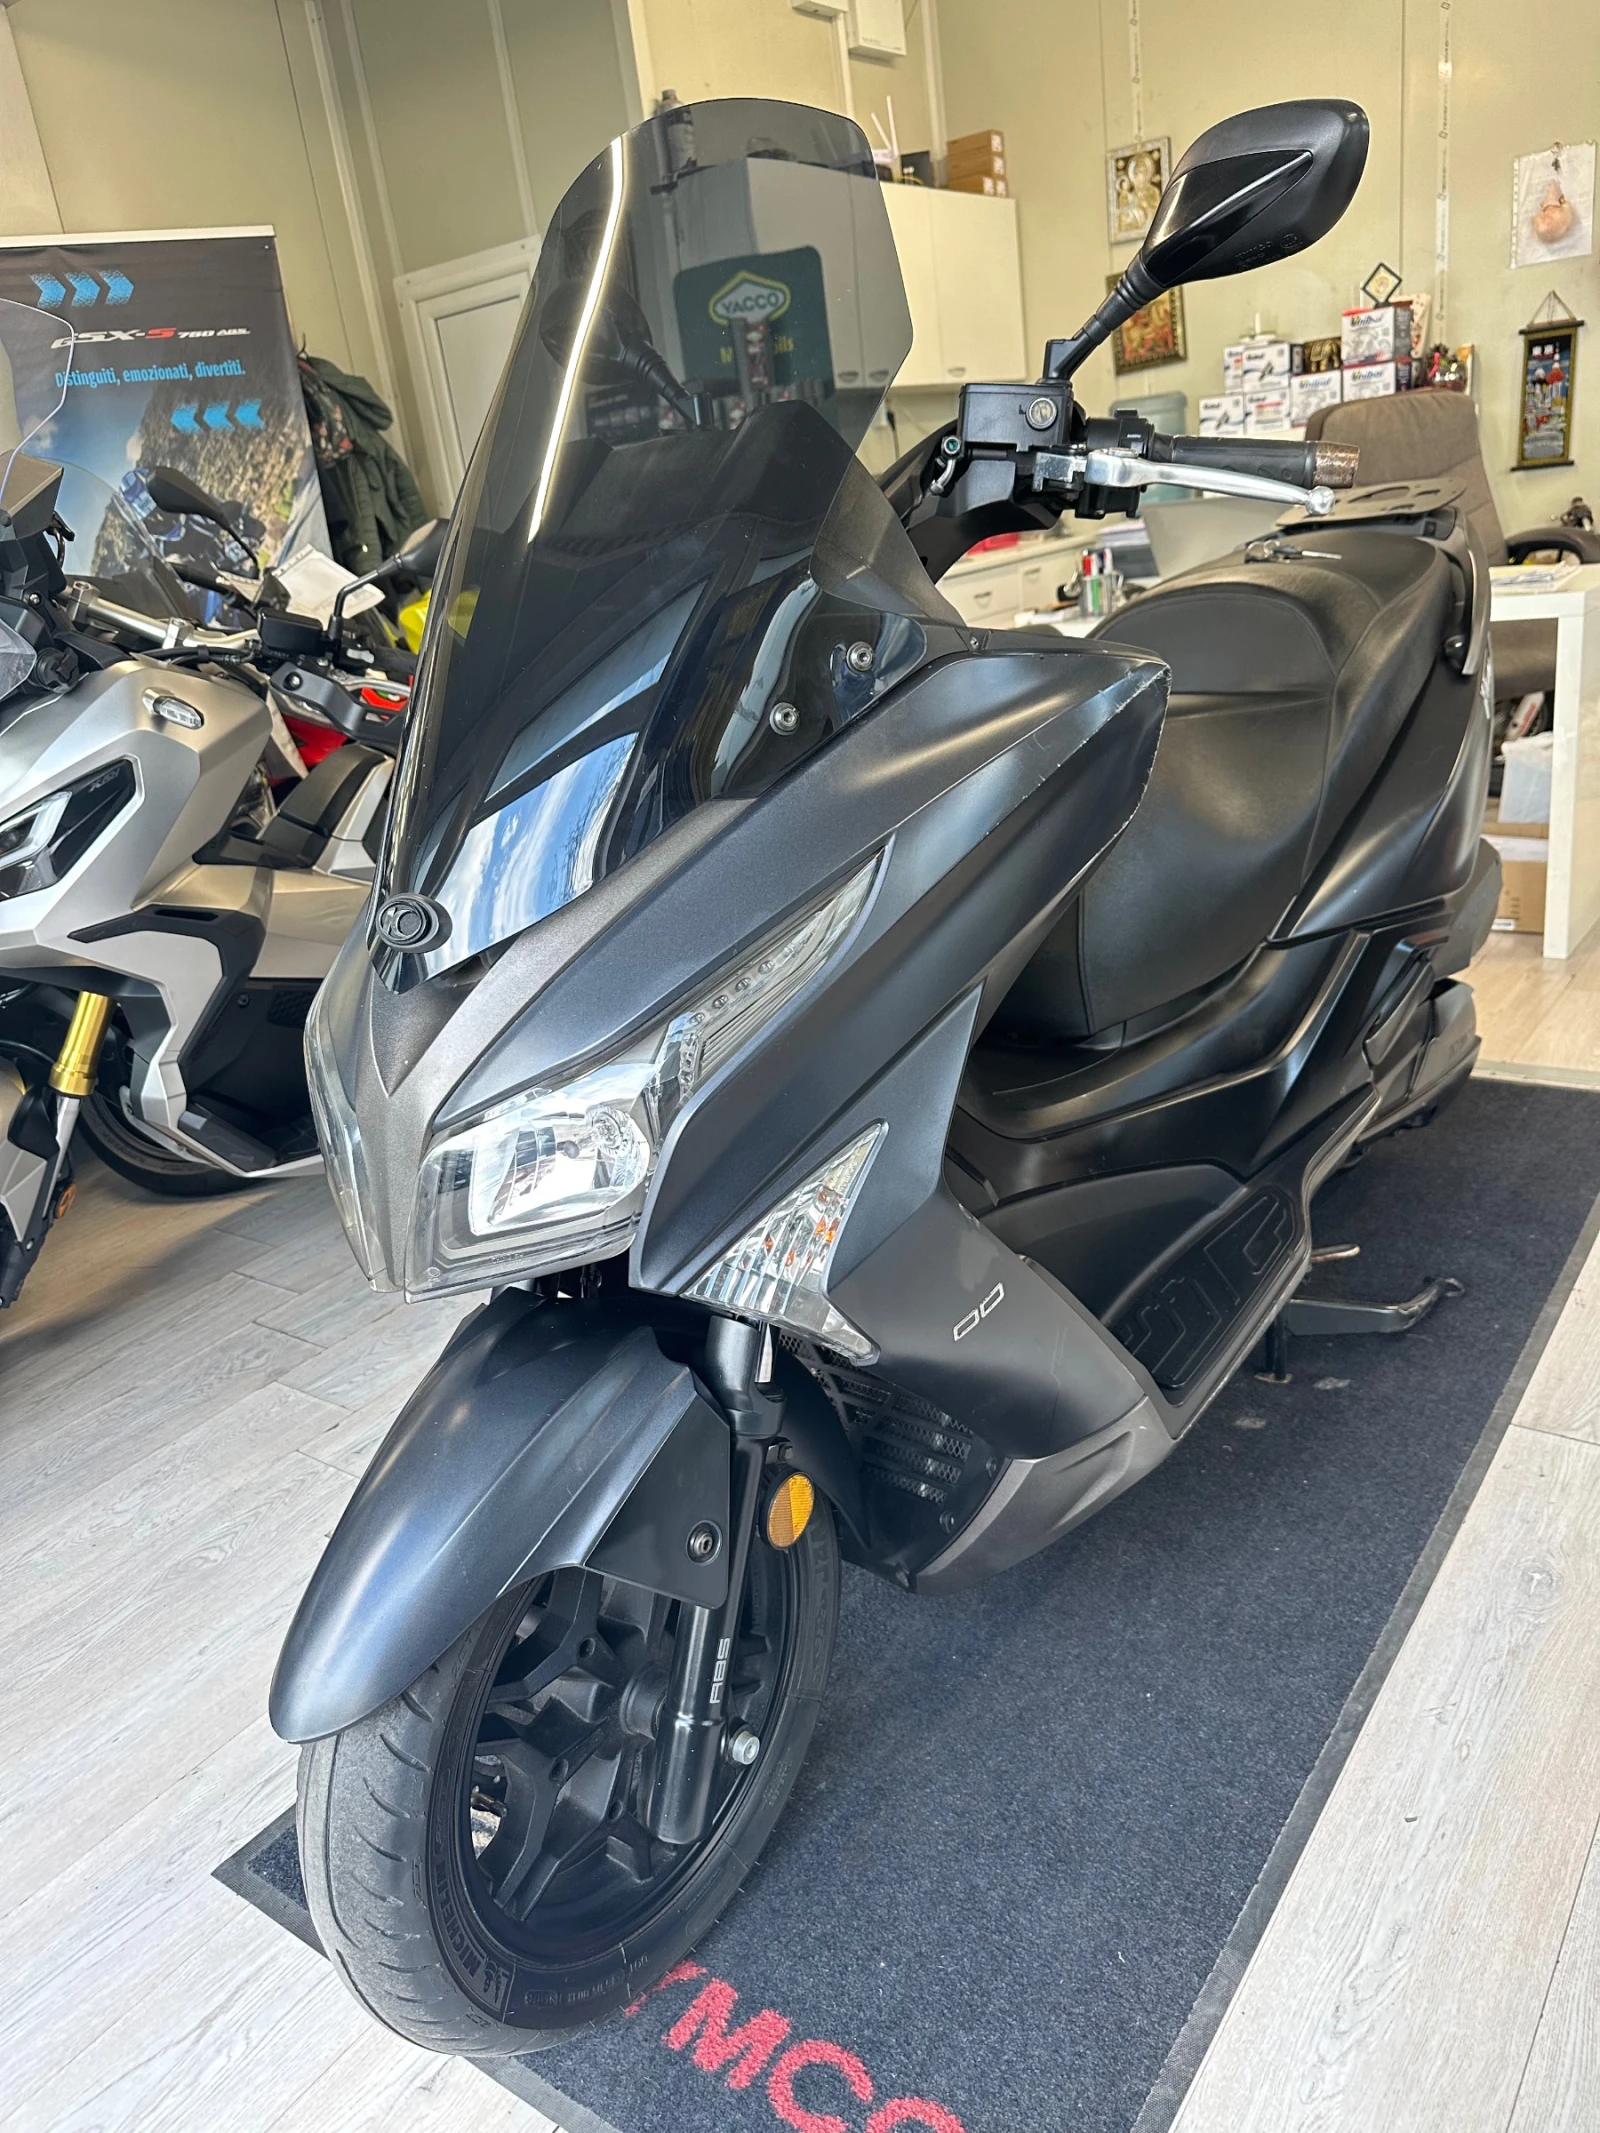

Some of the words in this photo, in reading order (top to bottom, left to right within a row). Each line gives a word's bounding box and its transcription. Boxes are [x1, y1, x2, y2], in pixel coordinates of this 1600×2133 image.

[721, 293, 779, 314] YACCO
[51, 327, 176, 349] GSX-S
[55, 367, 121, 389] Distinguiti,
[123, 362, 193, 382] emozionati,
[195, 358, 246, 378] divertiti.
[709, 1637, 730, 1704] ABS
[435, 1861, 482, 1978] MICHELIN
